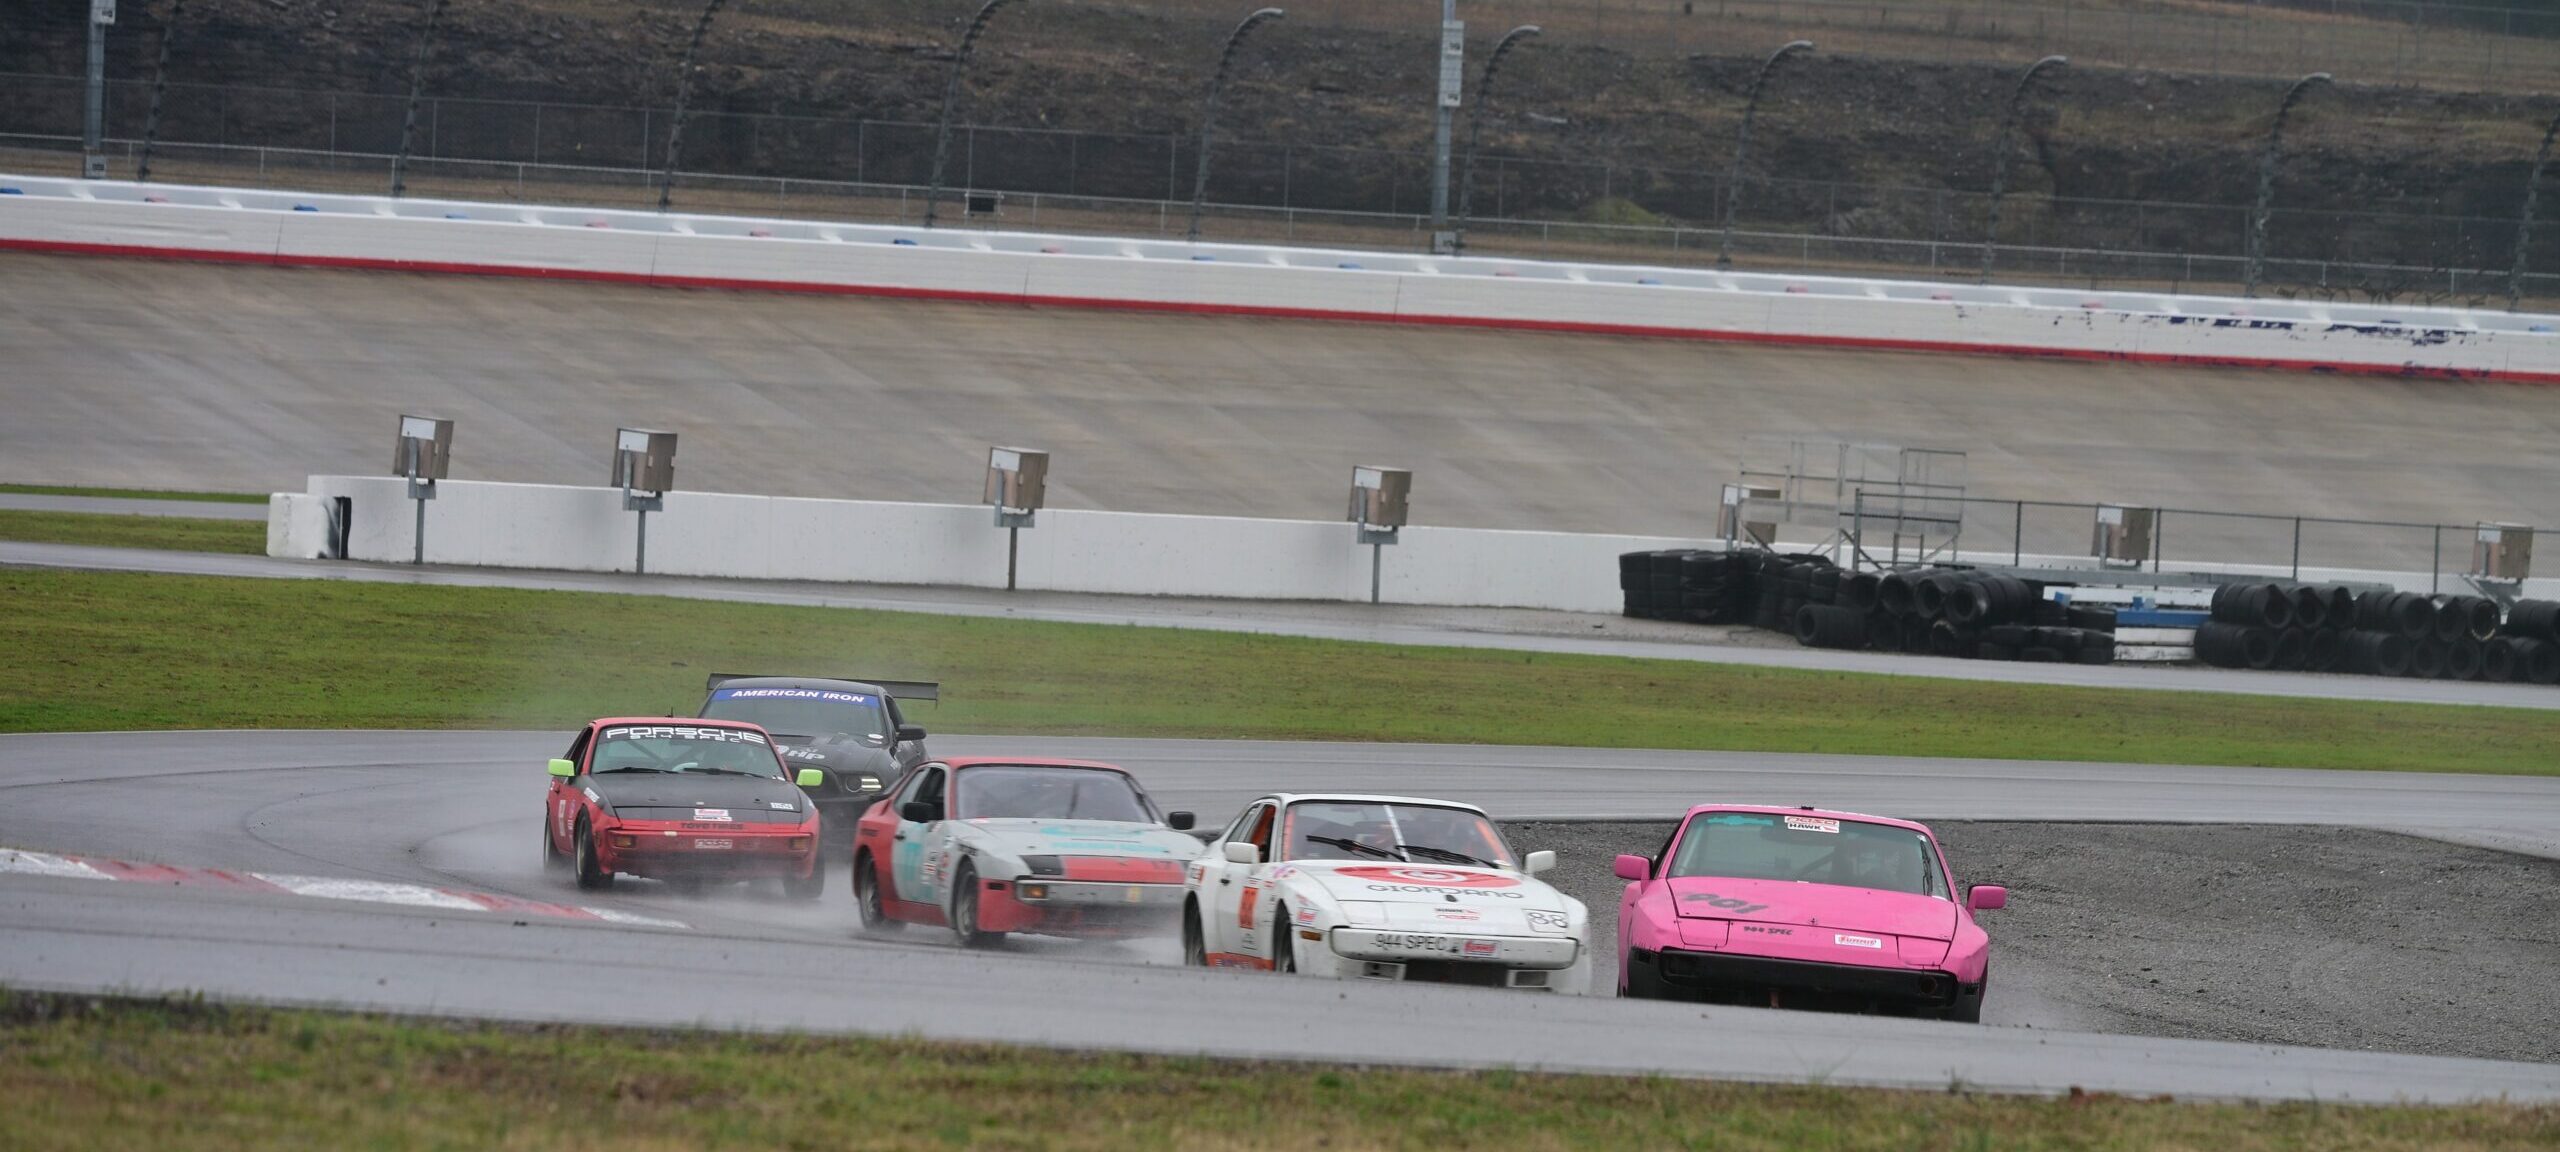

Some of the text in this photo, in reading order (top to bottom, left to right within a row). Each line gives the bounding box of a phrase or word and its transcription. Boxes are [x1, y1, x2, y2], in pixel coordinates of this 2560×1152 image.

[732, 690, 865, 703] AMERICAN IRON
[606, 727, 765, 745] PORSCHE
[1367, 884, 1523, 899] GIORDANO
[1684, 892, 1769, 914] 901
[1528, 911, 1569, 929] 88
[1375, 933, 1448, 950] 944 SPEC
